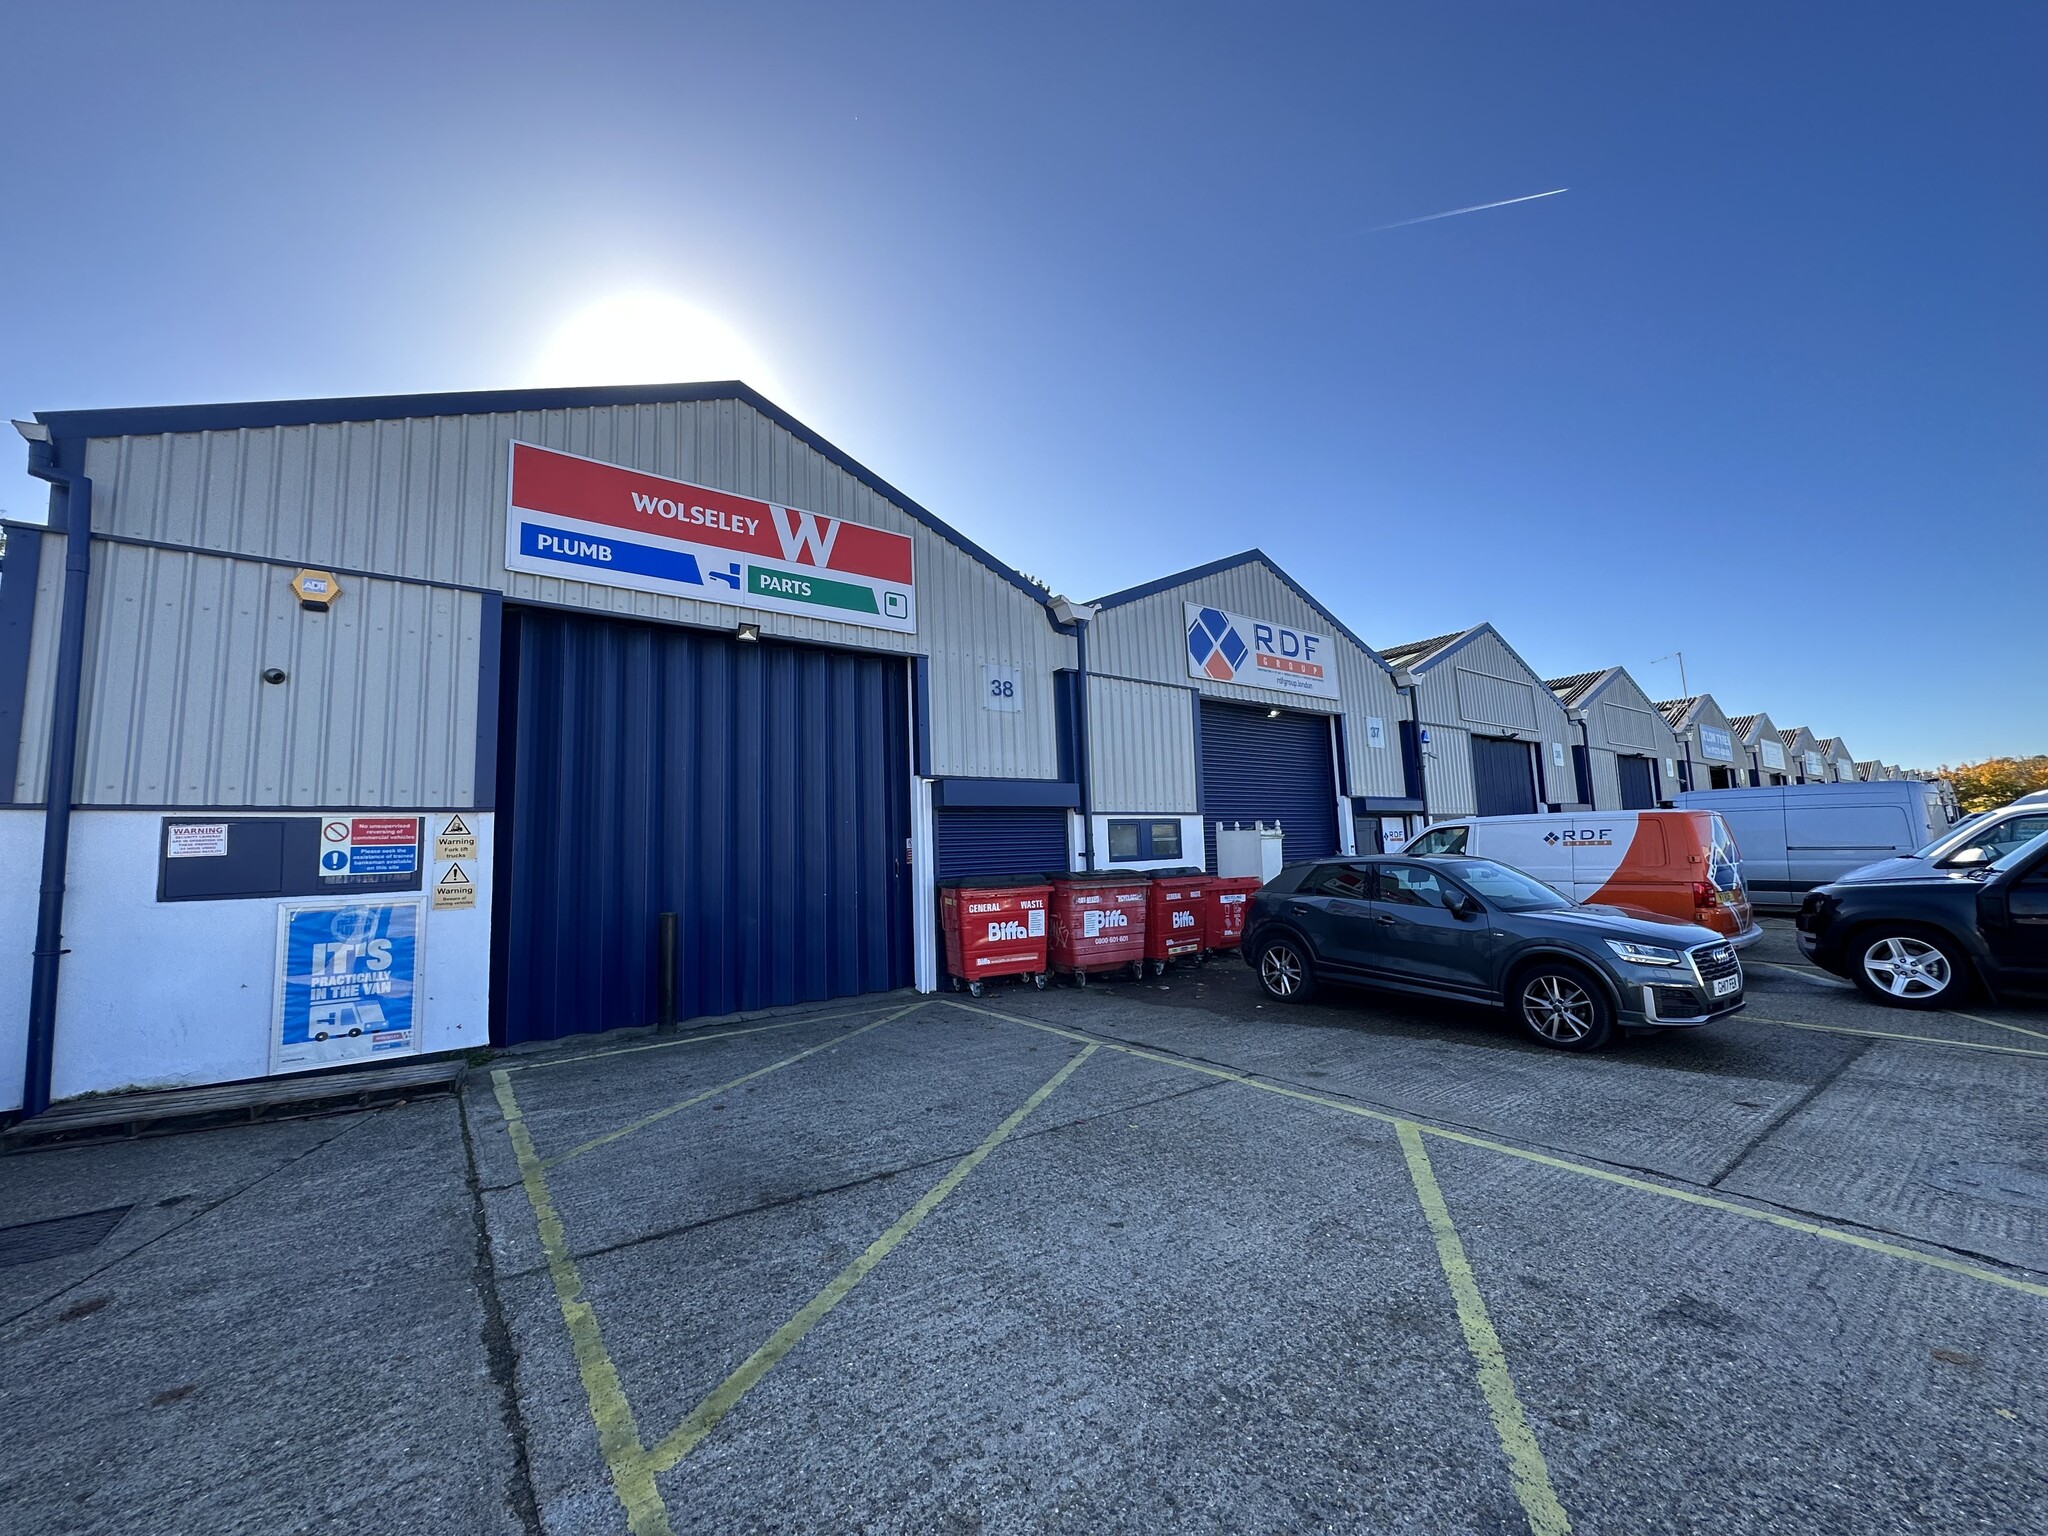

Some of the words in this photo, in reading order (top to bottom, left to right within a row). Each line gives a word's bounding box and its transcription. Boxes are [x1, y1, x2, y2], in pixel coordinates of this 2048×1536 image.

[631, 492, 759, 536] WOLSELEY
[769, 505, 841, 568] W
[537, 534, 613, 562] PLUMB
[303, 581, 326, 591] ADT
[760, 574, 812, 597] PARTS
[1253, 623, 1320, 660] RDF
[1263, 657, 1318, 674] GROUP
[991, 679, 1014, 698] 38
[1370, 726, 1380, 739] 37
[438, 838, 475, 846] Warning
[1389, 830, 1403, 838] RDF
[1563, 829, 1612, 840] RDF
[436, 887, 473, 895] Warning
[968, 903, 1001, 913] GENERAL
[1020, 899, 1044, 909] WASTE
[1097, 909, 1128, 929] Biffa
[1172, 910, 1195, 929] Biffa
[988, 920, 1027, 942] Biffa
[311, 938, 393, 976] IT'S
[311, 971, 392, 988] PRACTICALLY
[310, 987, 327, 1001] IN
[330, 984, 360, 998] THE
[363, 981, 392, 996] VAN
